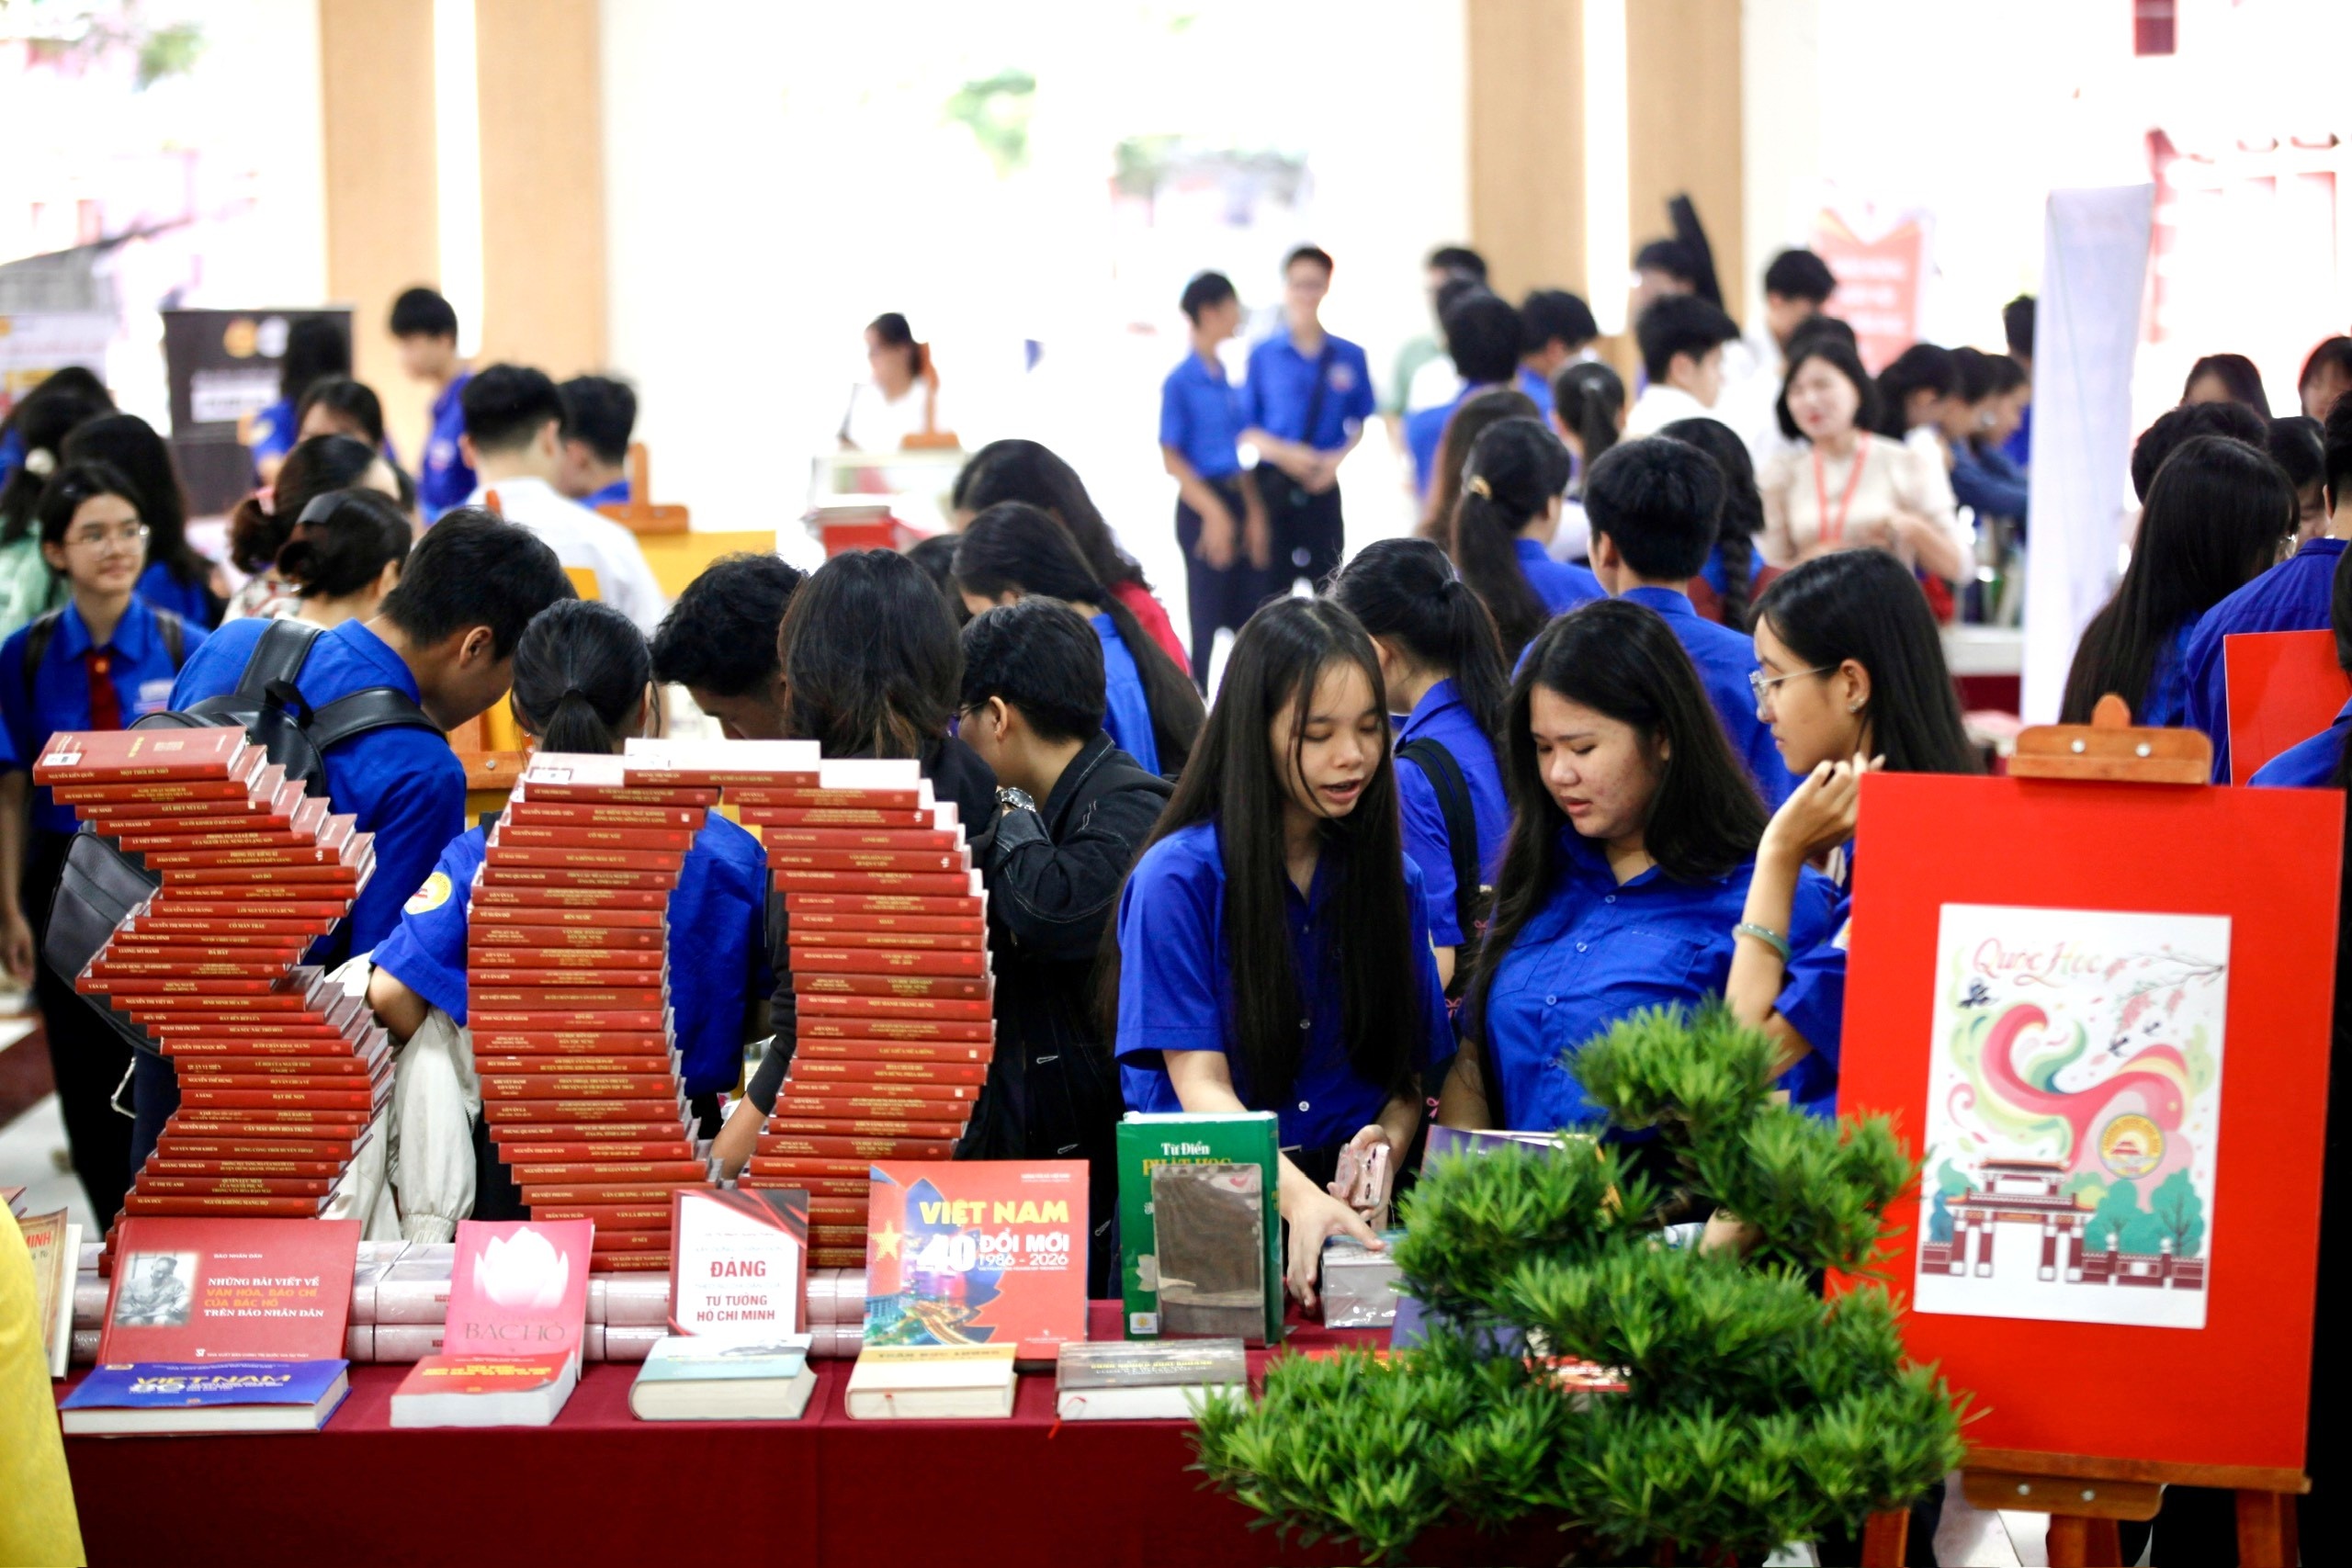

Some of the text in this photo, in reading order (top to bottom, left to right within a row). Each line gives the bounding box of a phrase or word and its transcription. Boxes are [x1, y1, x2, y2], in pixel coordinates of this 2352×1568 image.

[1181, 1141, 1210, 1156] Điển
[919, 1200, 1069, 1226] VIỆT NAM
[915, 1228, 1069, 1271] 40 ĐỔI MỚI
[978, 1254, 1015, 1267] 1986
[1029, 1253, 1069, 1267] 2026
[710, 1257, 766, 1278] ĐẢNG
[208, 1277, 250, 1286] NHỮNG
[252, 1277, 272, 1286] BÀI
[275, 1277, 301, 1286] VIẾT
[206, 1288, 232, 1297] VĂN
[268, 1288, 294, 1297] BÁO
[298, 1288, 317, 1297] CHÍ
[706, 1292, 767, 1306] TƯ TƯỞNG
[204, 1298, 228, 1306] CỦA
[261, 1298, 278, 1306] HỒ
[204, 1308, 323, 1317] TRÊN BÁO NHÂN DÂN
[696, 1308, 714, 1322] HỒ
[741, 1310, 775, 1321] MINH
